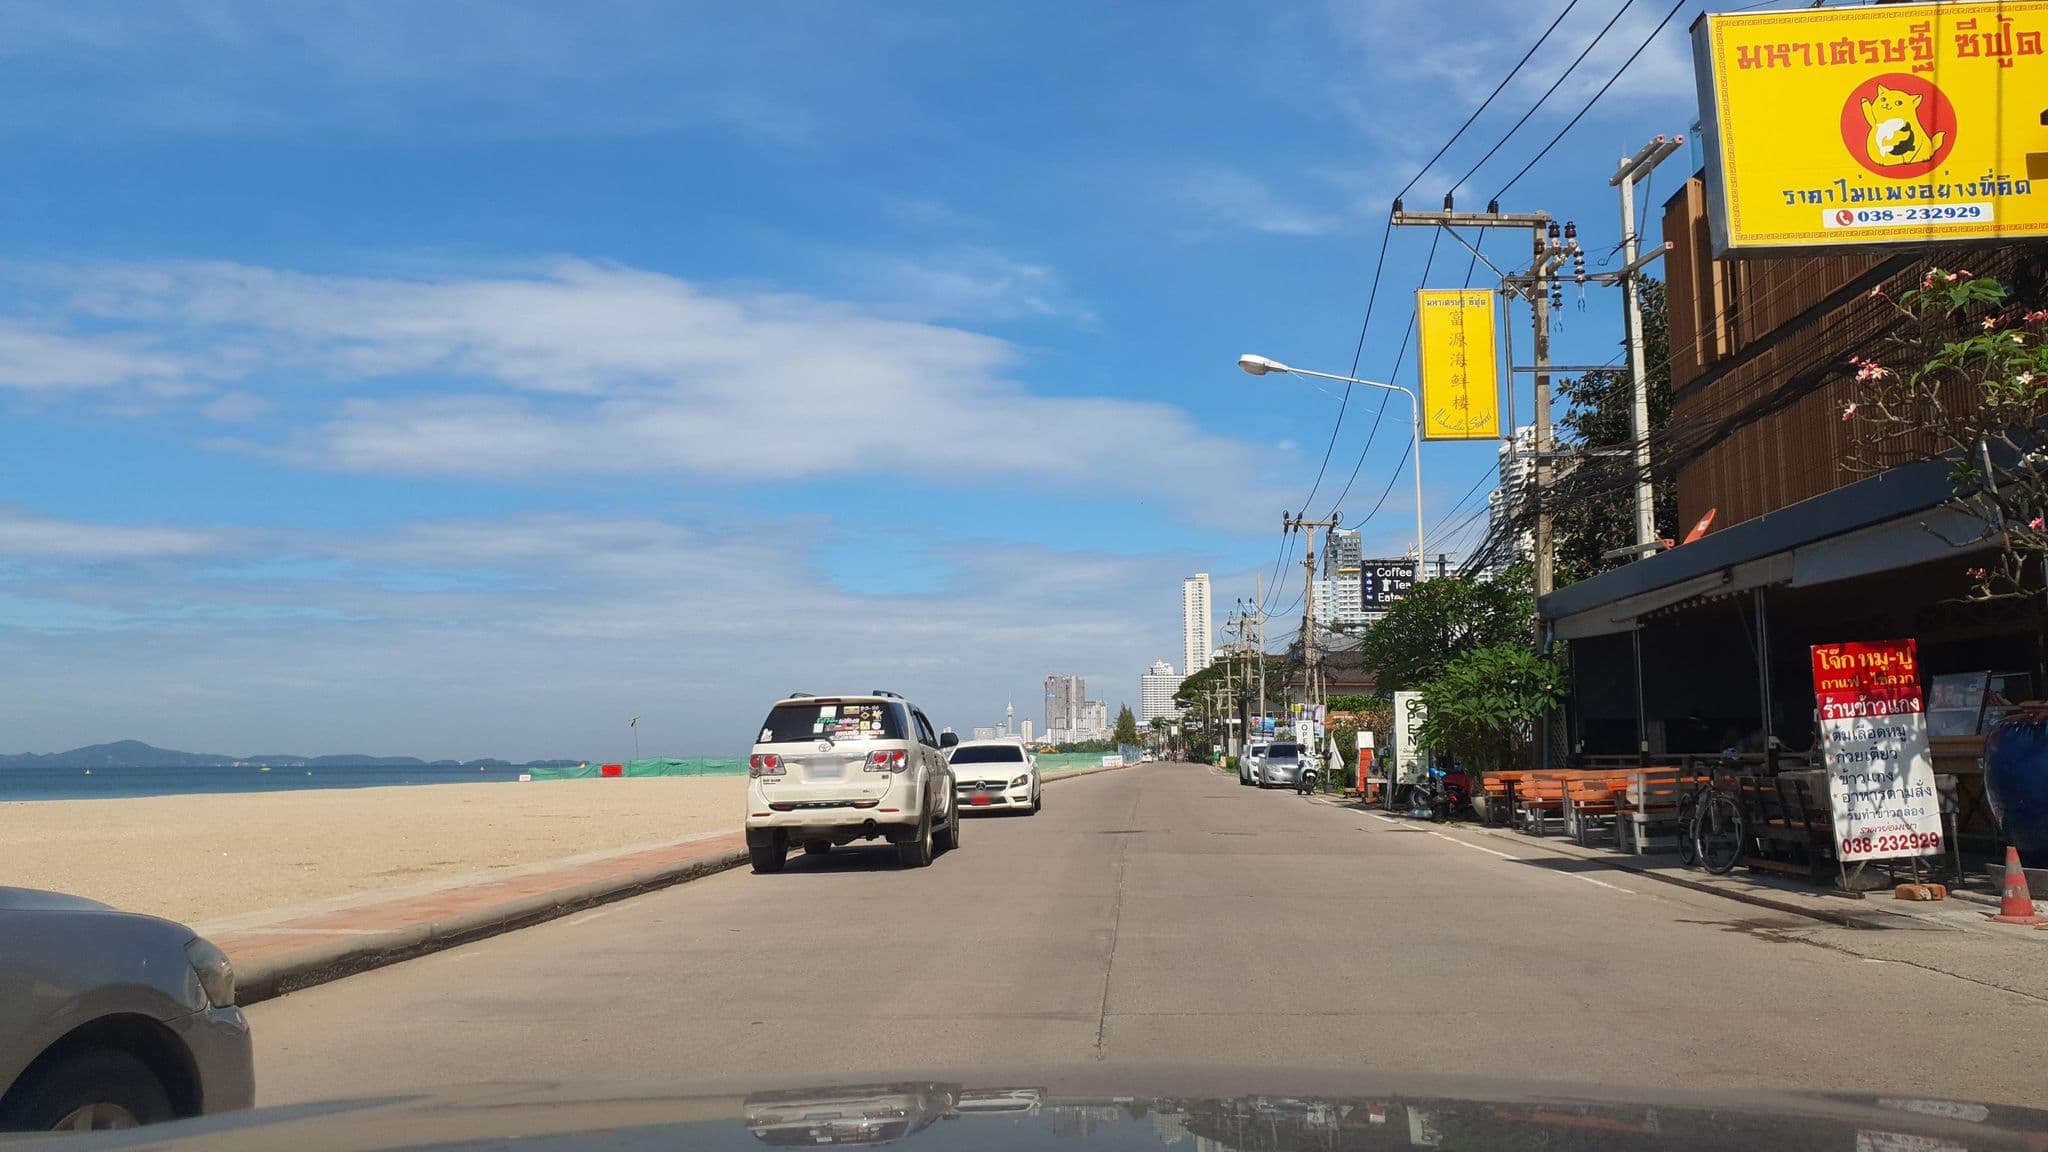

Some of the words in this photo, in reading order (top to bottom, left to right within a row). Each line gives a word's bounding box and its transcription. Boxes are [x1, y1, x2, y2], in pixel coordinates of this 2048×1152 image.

[1736, 20, 1935, 73] มหาเศรษฐี
[1954, 13, 2044, 69] ซีฟู้ด
[1782, 168, 2032, 206] ราคาไม่แพงอย่างที่คิด
[1857, 205, 1981, 223] 038-232929
[1376, 567, 1412, 577] Coffee
[1816, 648, 1855, 670] โจ๊ก
[1821, 674, 1860, 690] กาแฟ
[1823, 694, 1920, 718] ร้านข้าวแกง
[1405, 699, 1418, 747] OPEN
[1839, 768, 1894, 785] ข้าวแกง
[1842, 779, 1932, 803] อาหารตามสั่ง
[1842, 832, 1940, 855] 038-232929
